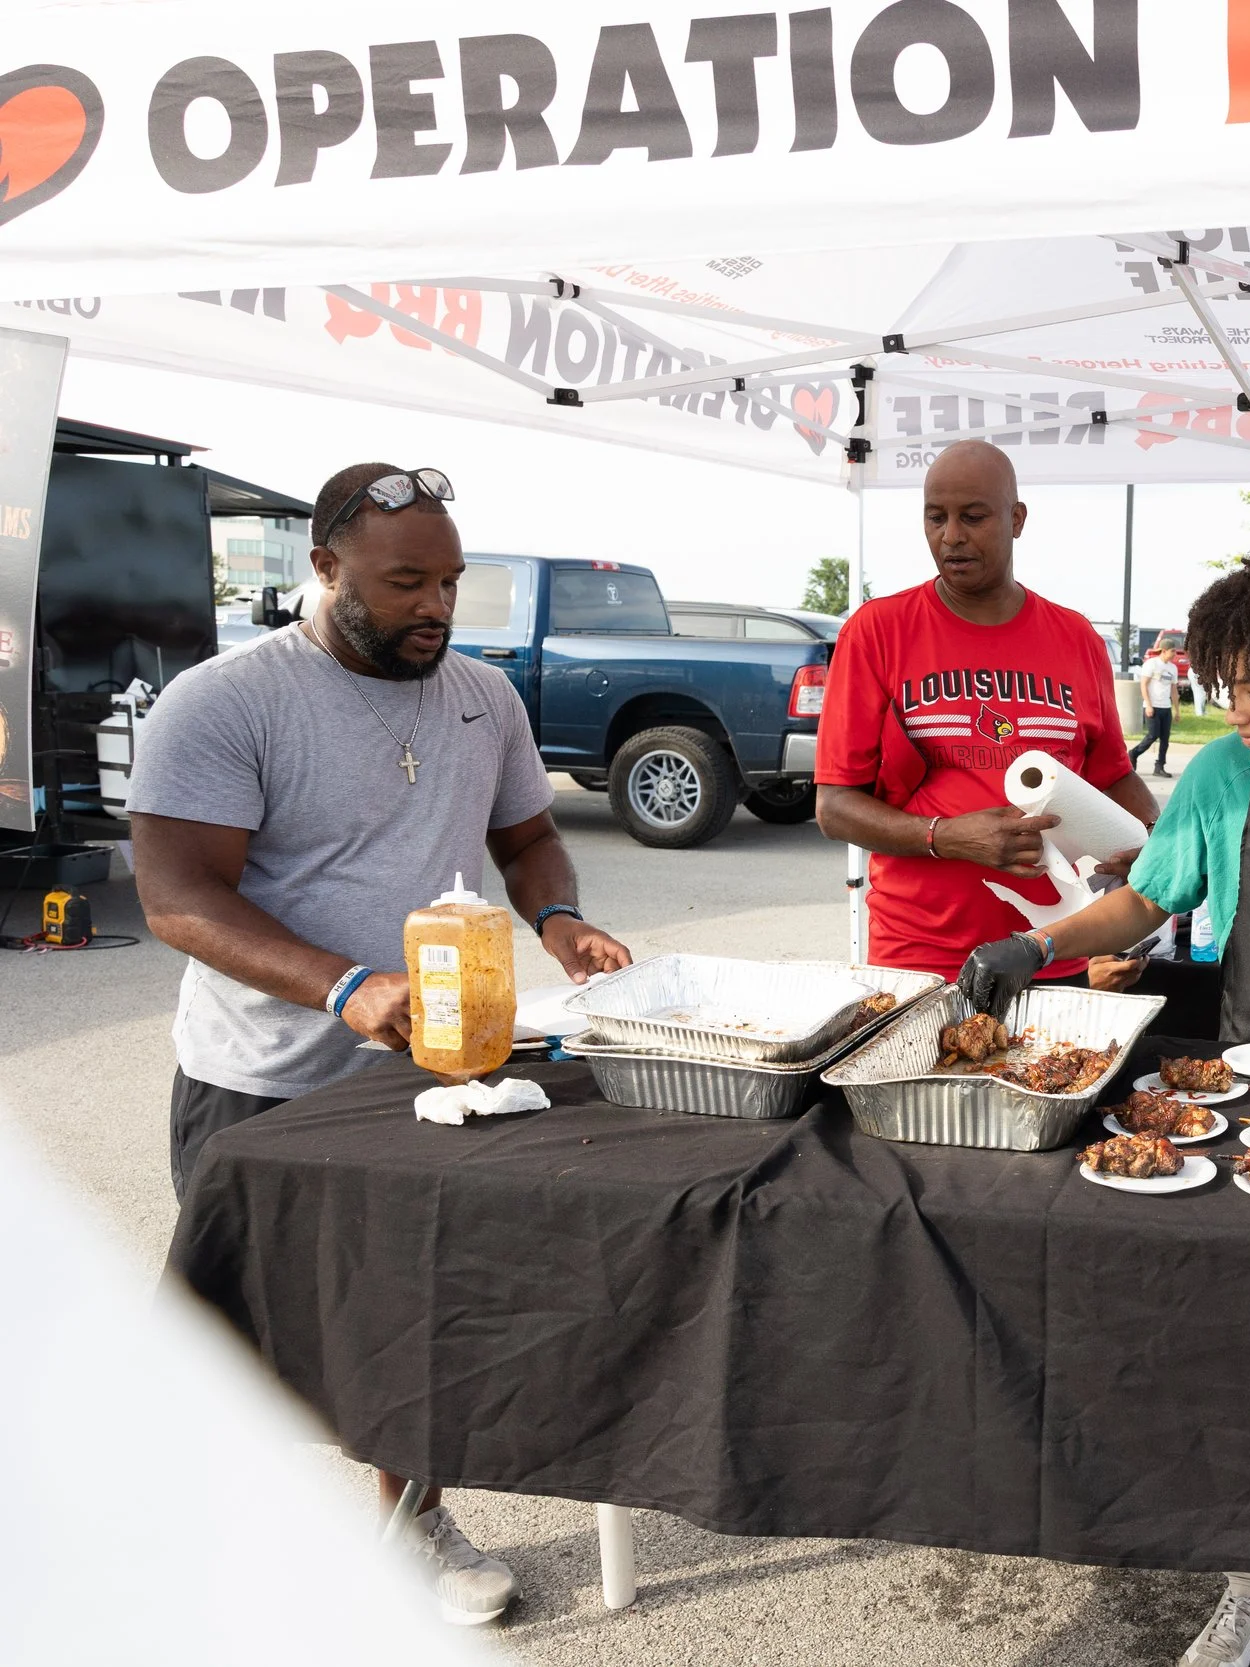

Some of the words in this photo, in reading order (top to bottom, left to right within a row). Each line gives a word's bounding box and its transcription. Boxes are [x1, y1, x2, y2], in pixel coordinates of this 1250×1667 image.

[147, 0, 1142, 195] OPERATION
[0, 504, 32, 539] MS
[903, 668, 1076, 716] LOUISVILLE
